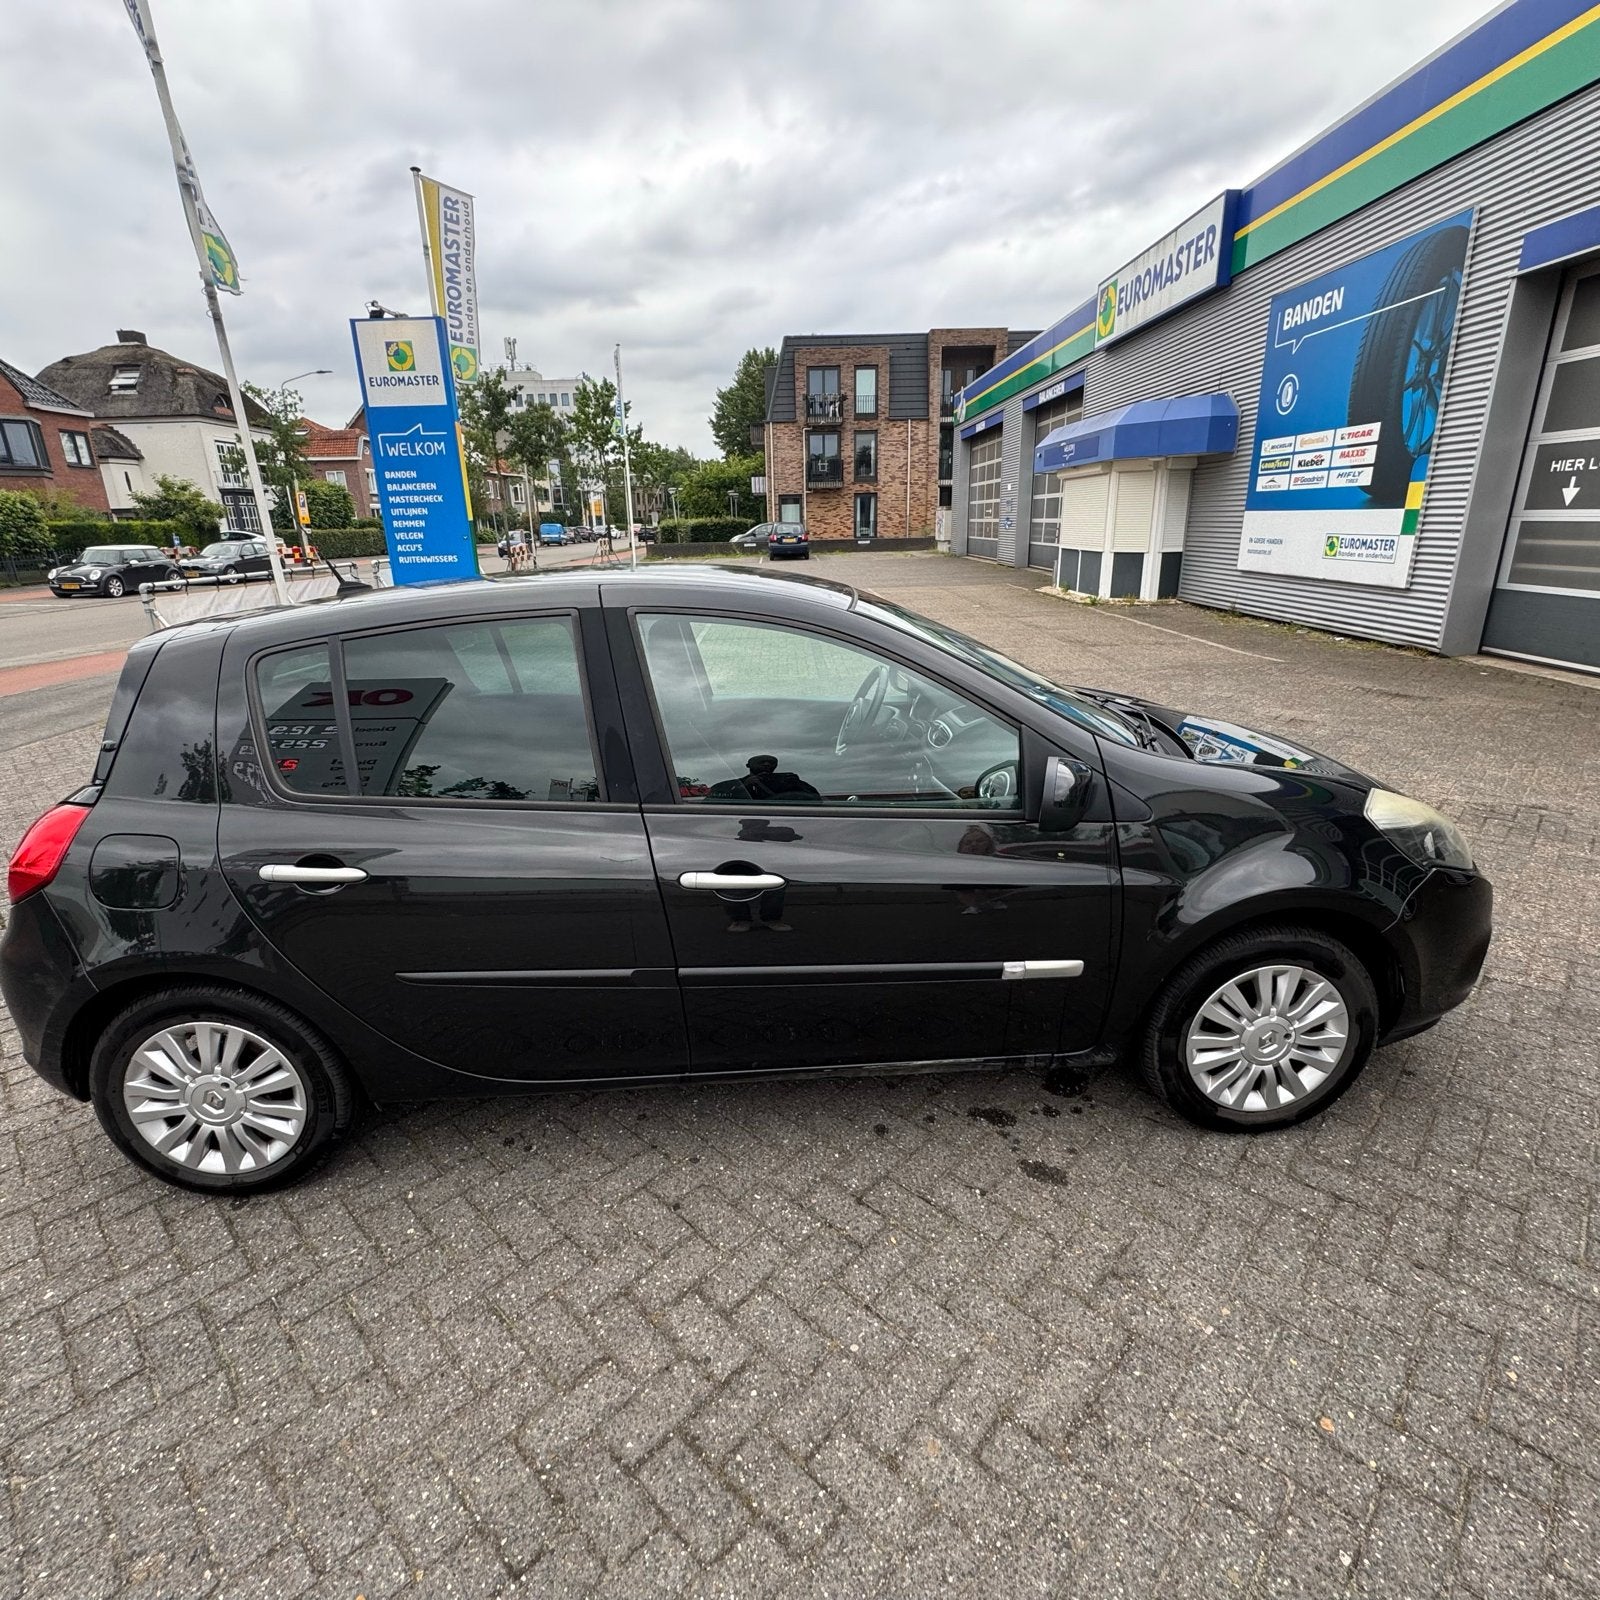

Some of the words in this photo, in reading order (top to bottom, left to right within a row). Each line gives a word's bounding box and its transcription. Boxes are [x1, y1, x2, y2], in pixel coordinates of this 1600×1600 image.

[462, 201, 471, 272] onderhoud
[443, 196, 463, 342] EUROMASTER
[1117, 224, 1216, 317] EUROMASTER
[465, 277, 472, 292] en
[1283, 287, 1344, 331] BANDEN
[465, 298, 475, 344] Banden
[369, 375, 439, 388] EUROMASTER
[1347, 429, 1373, 439] TIGAR
[386, 442, 446, 457] WELKOM
[1339, 449, 1367, 459] MAXXIS
[1550, 458, 1585, 472] HIER
[1588, 457, 1600, 470] L
[384, 470, 417, 479] BANDEN
[386, 482, 437, 491] BALANCEREN
[389, 495, 443, 504] MASTERCHECK
[391, 507, 428, 516] UITLIJNEN
[393, 519, 425, 528] REMMEN
[394, 531, 424, 540] VELGEN
[397, 543, 423, 552] ACCU'S
[1340, 538, 1395, 551] EUROMASTER
[398, 555, 458, 564] RUITENWISSERS
